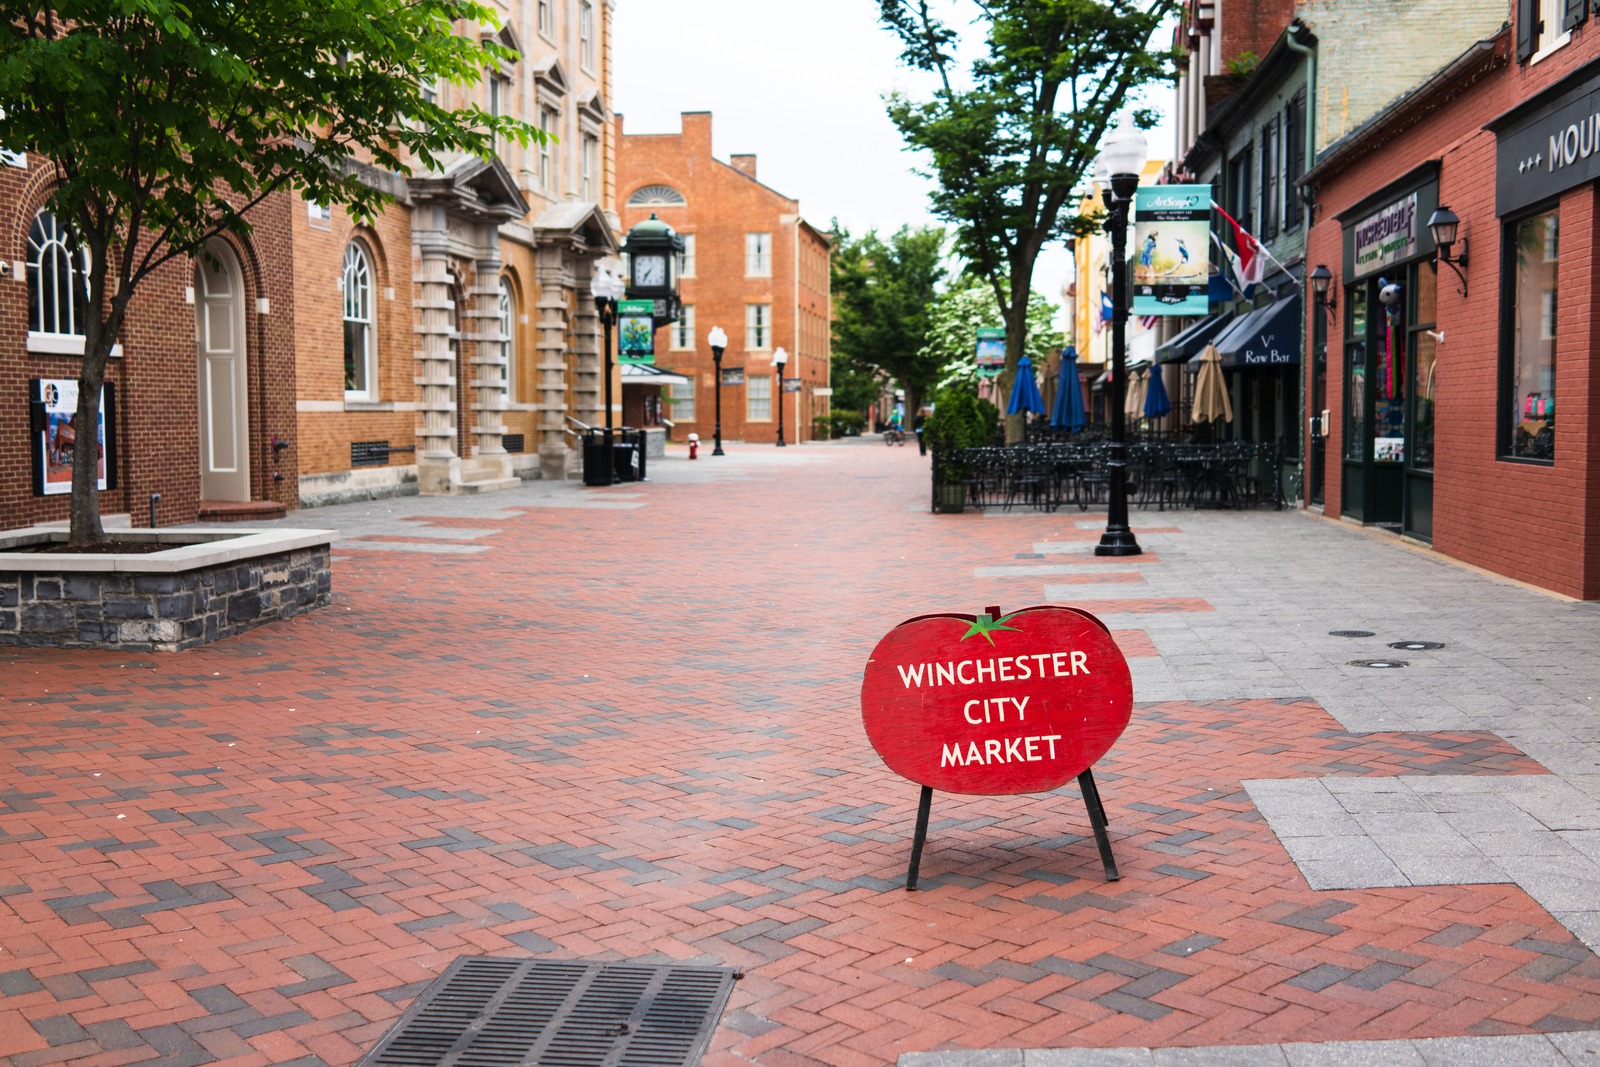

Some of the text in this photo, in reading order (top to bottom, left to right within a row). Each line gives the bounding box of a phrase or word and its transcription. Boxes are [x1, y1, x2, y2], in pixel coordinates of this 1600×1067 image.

[1355, 202, 1415, 265] INCREDIBLE
[1245, 349, 1290, 363] Raw Bar
[897, 651, 1091, 689] WINCHESTER
[963, 696, 1030, 725] CITY
[940, 734, 1062, 768] MARKET
